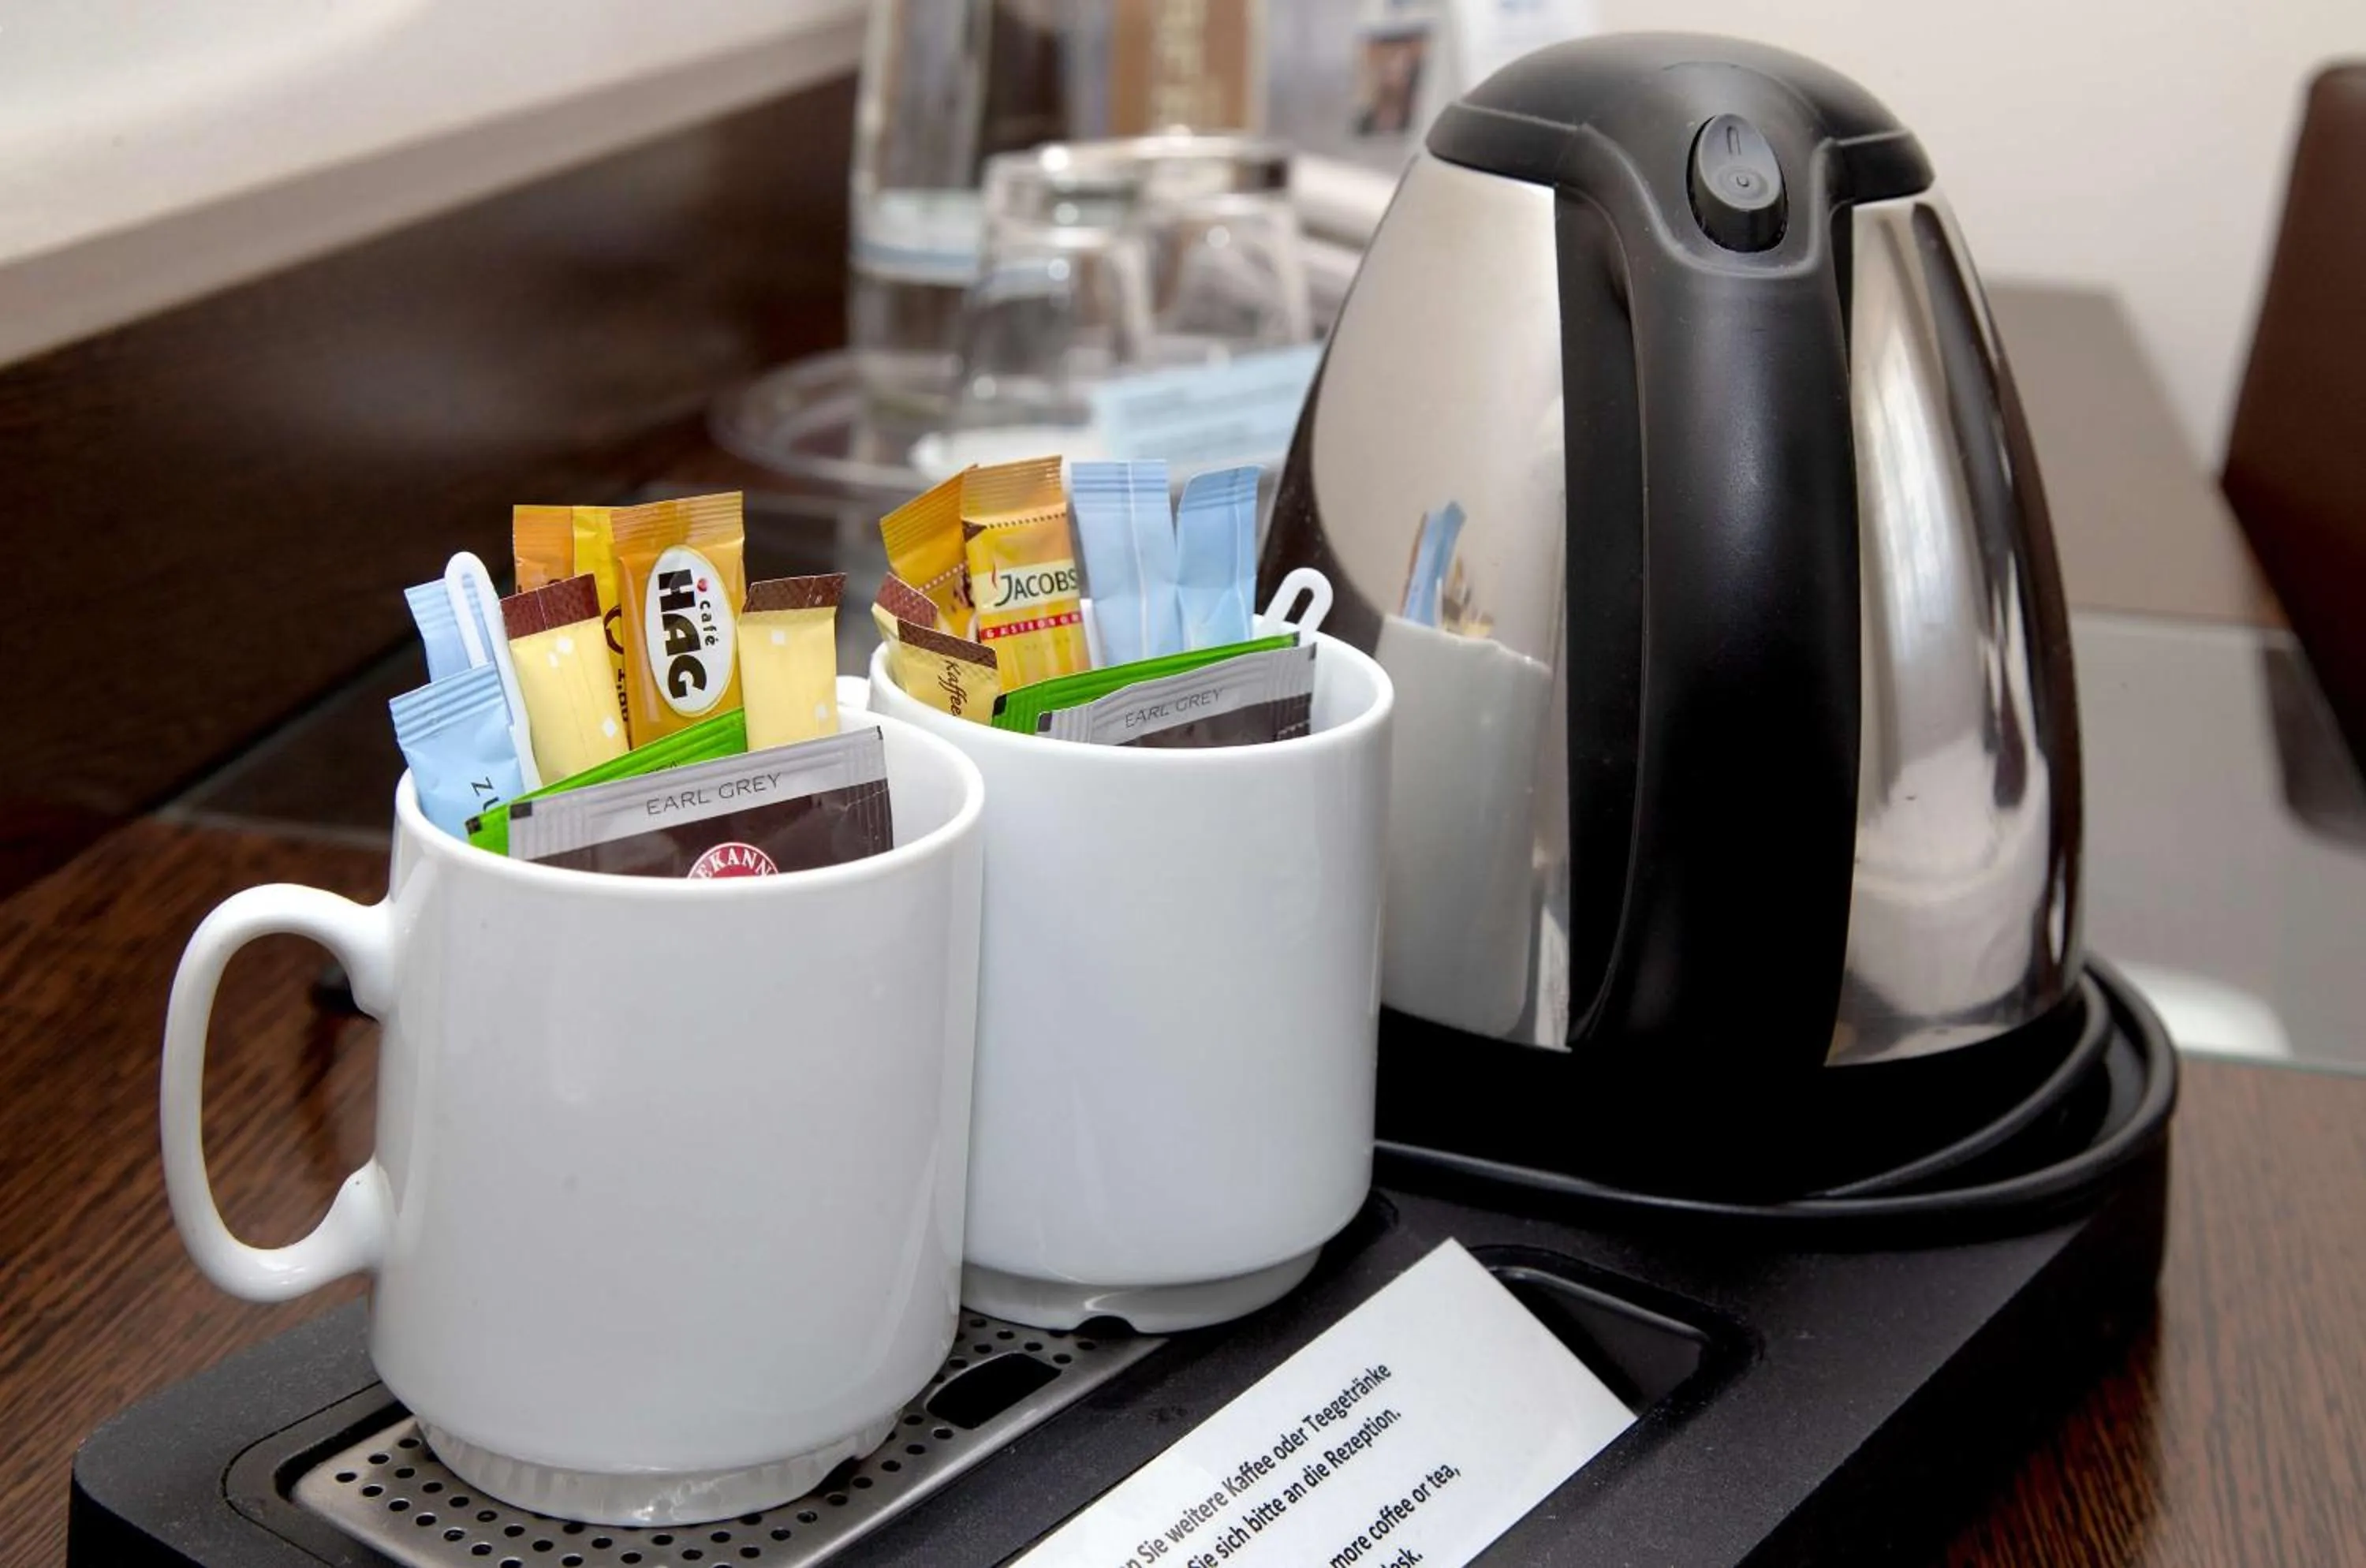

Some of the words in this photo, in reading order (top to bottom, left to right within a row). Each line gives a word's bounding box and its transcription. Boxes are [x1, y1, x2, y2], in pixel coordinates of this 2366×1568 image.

[995, 569, 1079, 607] JACOBS
[659, 569, 707, 699] HAG
[699, 599, 719, 647] café
[938, 659, 968, 717] Kaffee
[1125, 705, 1170, 728] EARL
[1175, 689, 1222, 711] GREY
[647, 790, 711, 815] EARL
[719, 772, 781, 799] GREY
[1136, 1540, 1168, 1564] Sie
[1165, 1491, 1228, 1543] weitere
[1222, 1454, 1276, 1497] Kaffee
[1272, 1427, 1309, 1460] oder
[1302, 1364, 1392, 1432] Teegetränke
[1215, 1526, 1252, 1559] sich
[1242, 1498, 1283, 1533] bitte
[1282, 1481, 1308, 1504] an
[1302, 1462, 1330, 1488] die
[1323, 1408, 1401, 1469] Rezeption.
[1329, 1535, 1372, 1568] more
[1368, 1497, 1415, 1540] coffee
[1412, 1483, 1431, 1503] or
[1425, 1464, 1461, 1489] tea,
